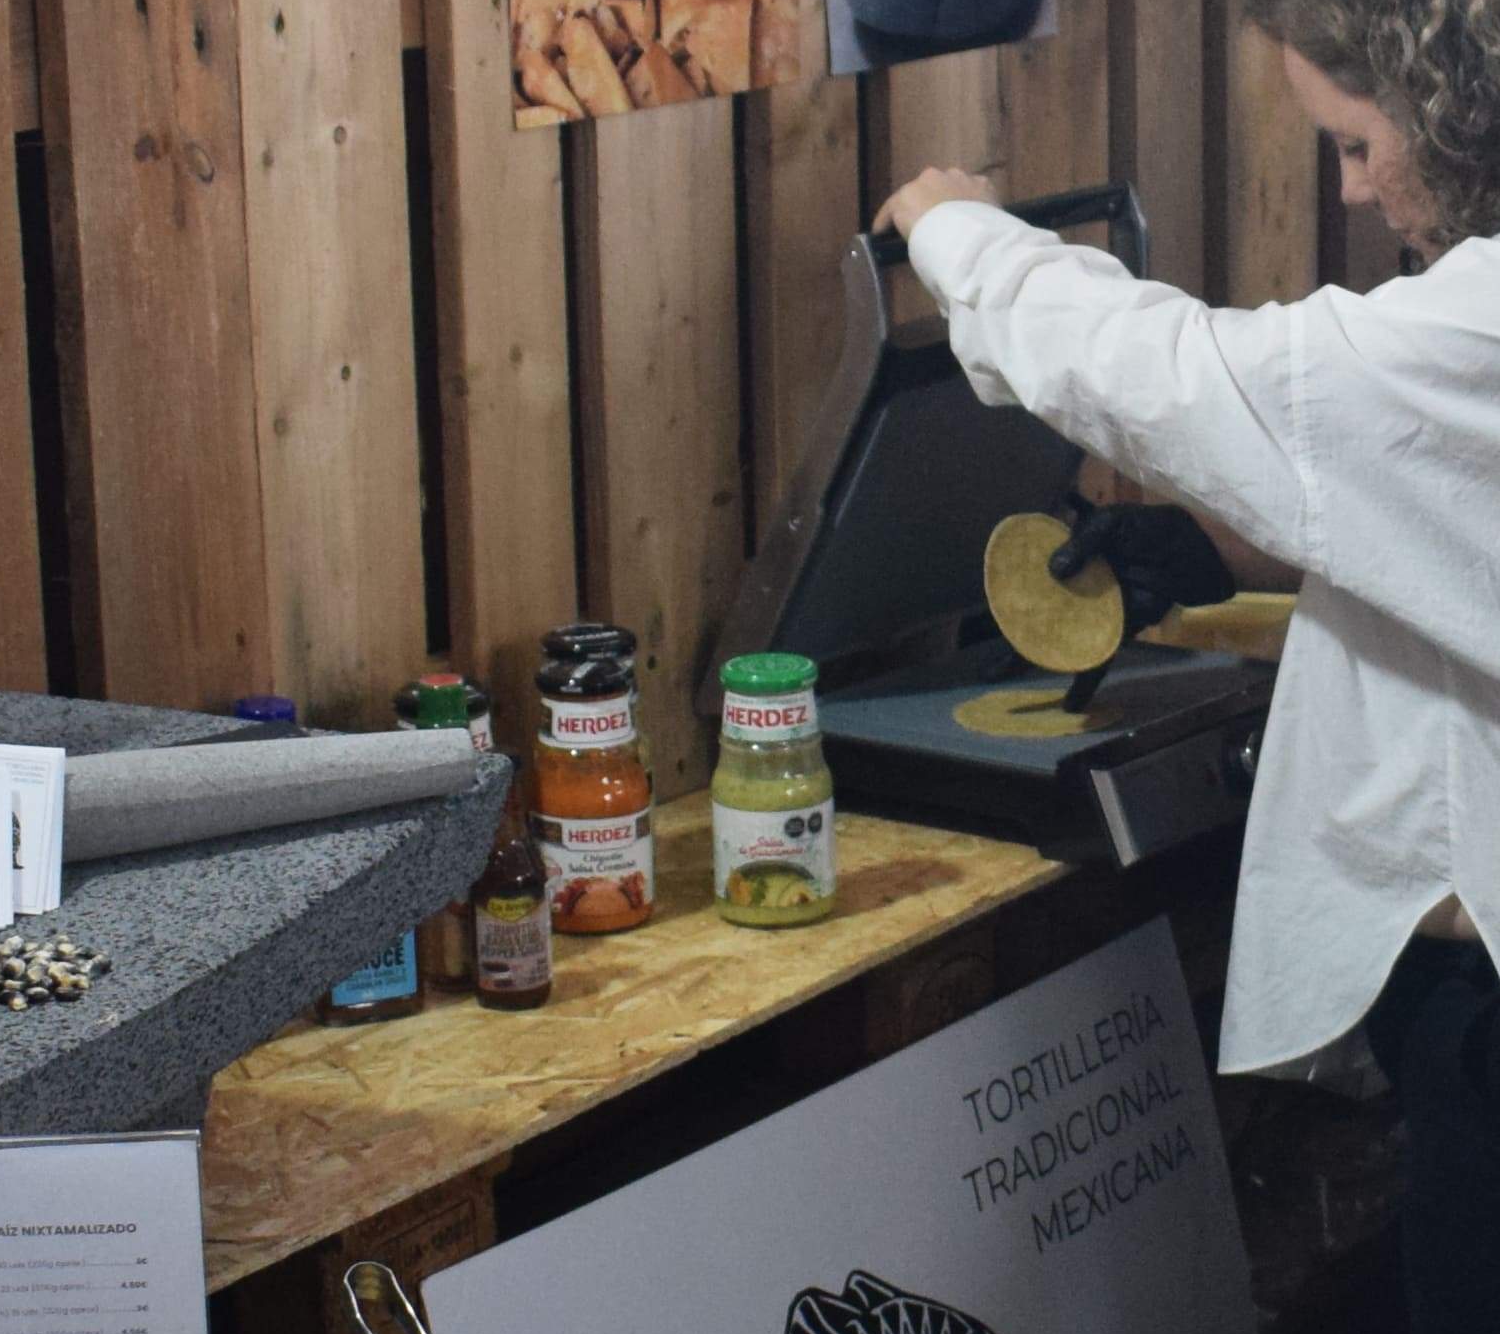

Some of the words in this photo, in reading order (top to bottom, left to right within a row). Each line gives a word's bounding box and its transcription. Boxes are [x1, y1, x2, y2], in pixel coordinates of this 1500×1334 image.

[557, 712, 628, 734] HERDEZ
[725, 705, 808, 728] HERDEZ
[568, 824, 633, 844] HERDEZ
[962, 992, 1166, 1133] TORTILLERÍA
[961, 1061, 1182, 1212] TRADICIONAL
[1031, 1125, 1196, 1253] MEXICANA
[21, 1223, 137, 1236] NIXTAMALIZADO
